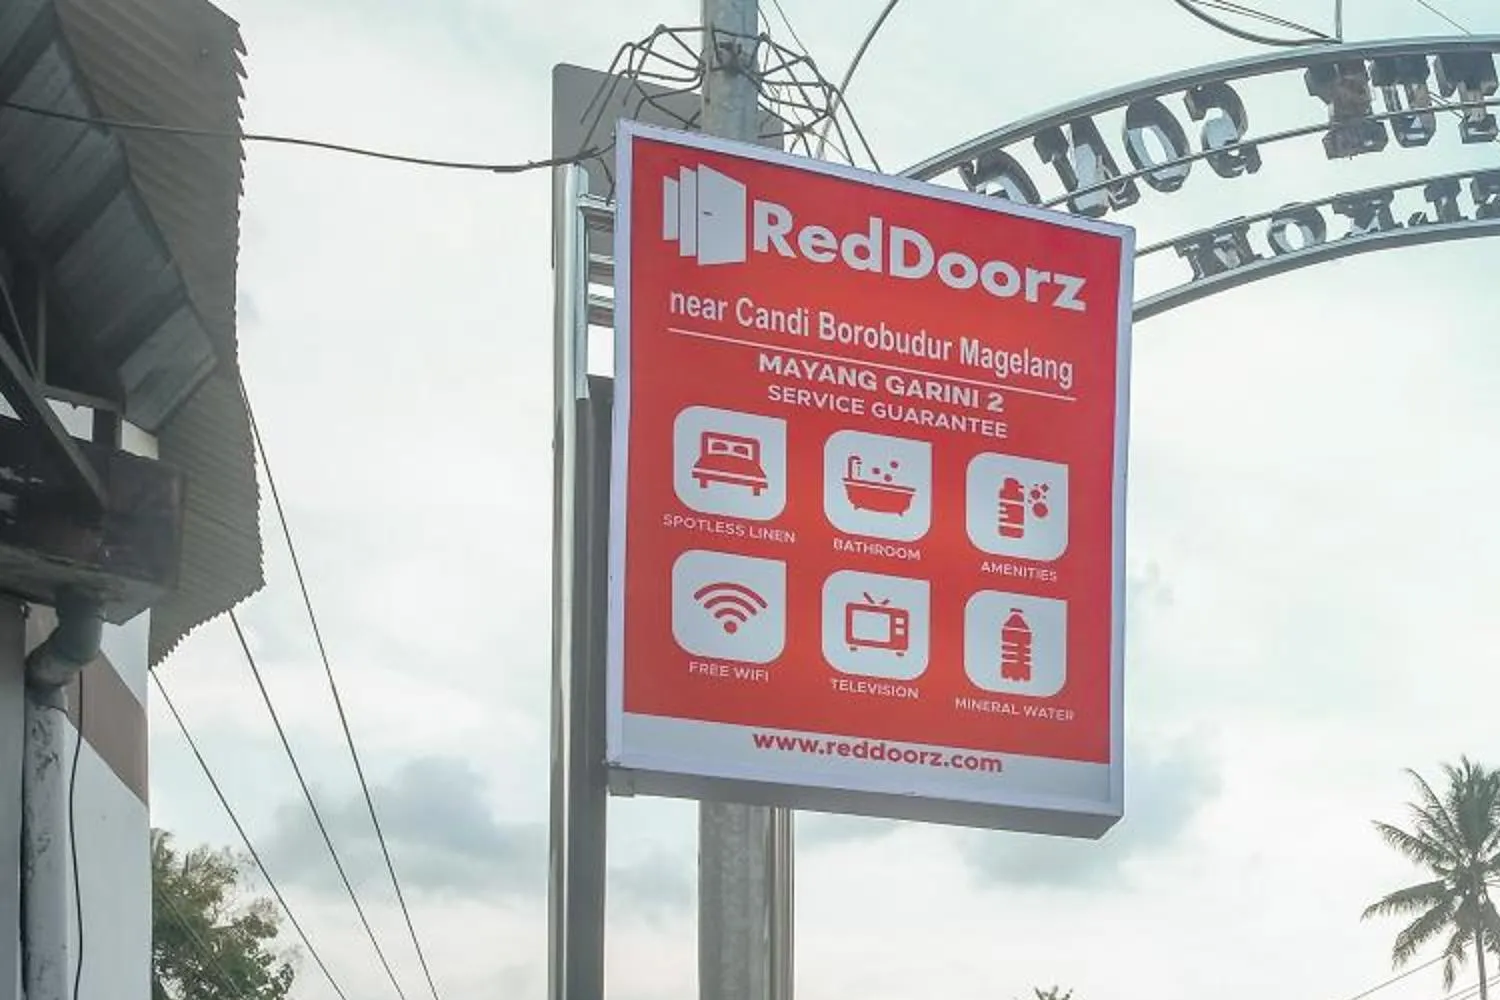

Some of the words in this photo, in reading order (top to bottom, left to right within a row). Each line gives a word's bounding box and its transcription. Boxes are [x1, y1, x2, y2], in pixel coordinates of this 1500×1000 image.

[754, 199, 1087, 311] RedDoorz
[671, 290, 727, 322] near
[736, 299, 810, 337] Candi
[820, 312, 953, 358] Borobudur
[961, 338, 1074, 389] Magelang
[759, 353, 878, 392] MAYANG
[886, 376, 980, 410] GARINI
[987, 391, 1004, 413] 2
[768, 385, 866, 416] SERVICE
[872, 404, 1008, 438] GUARANTEE
[662, 514, 746, 537] SPOTLESS
[749, 525, 796, 544] LINEN
[832, 540, 921, 561] BATHROOM
[980, 561, 1058, 582] AMENITIES
[688, 661, 730, 677] FREE
[733, 666, 770, 682] WIFI
[831, 678, 919, 699] TELEVISION
[954, 697, 1020, 716] MINERAL
[1022, 707, 1075, 722] WATER
[753, 731, 1003, 773] www.reddoorz.com
